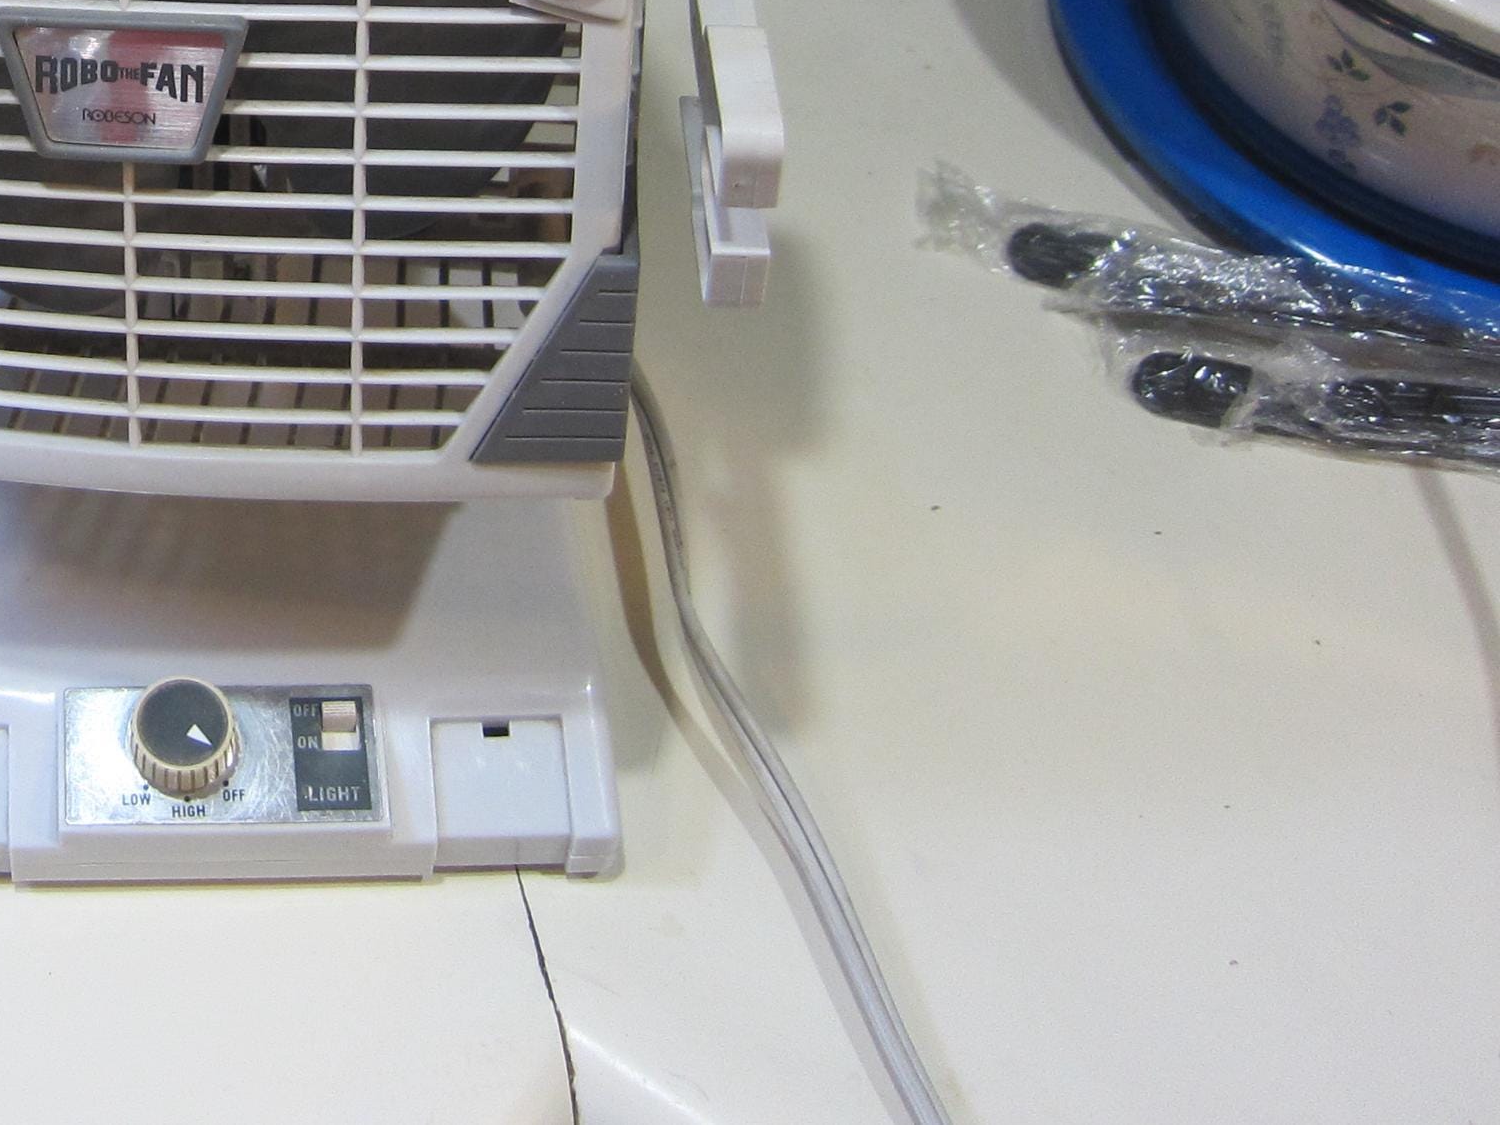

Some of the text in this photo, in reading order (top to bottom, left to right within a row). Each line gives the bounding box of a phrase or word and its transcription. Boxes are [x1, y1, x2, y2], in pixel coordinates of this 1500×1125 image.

[35, 55, 205, 103] ROBO THE FAN
[83, 108, 156, 125] ROBESON
[293, 703, 317, 717] OFF
[297, 736, 318, 749] ON
[122, 794, 151, 806] LOW
[223, 789, 245, 802] OFF
[307, 786, 360, 802] LIGHT
[172, 805, 206, 818] HIGH
